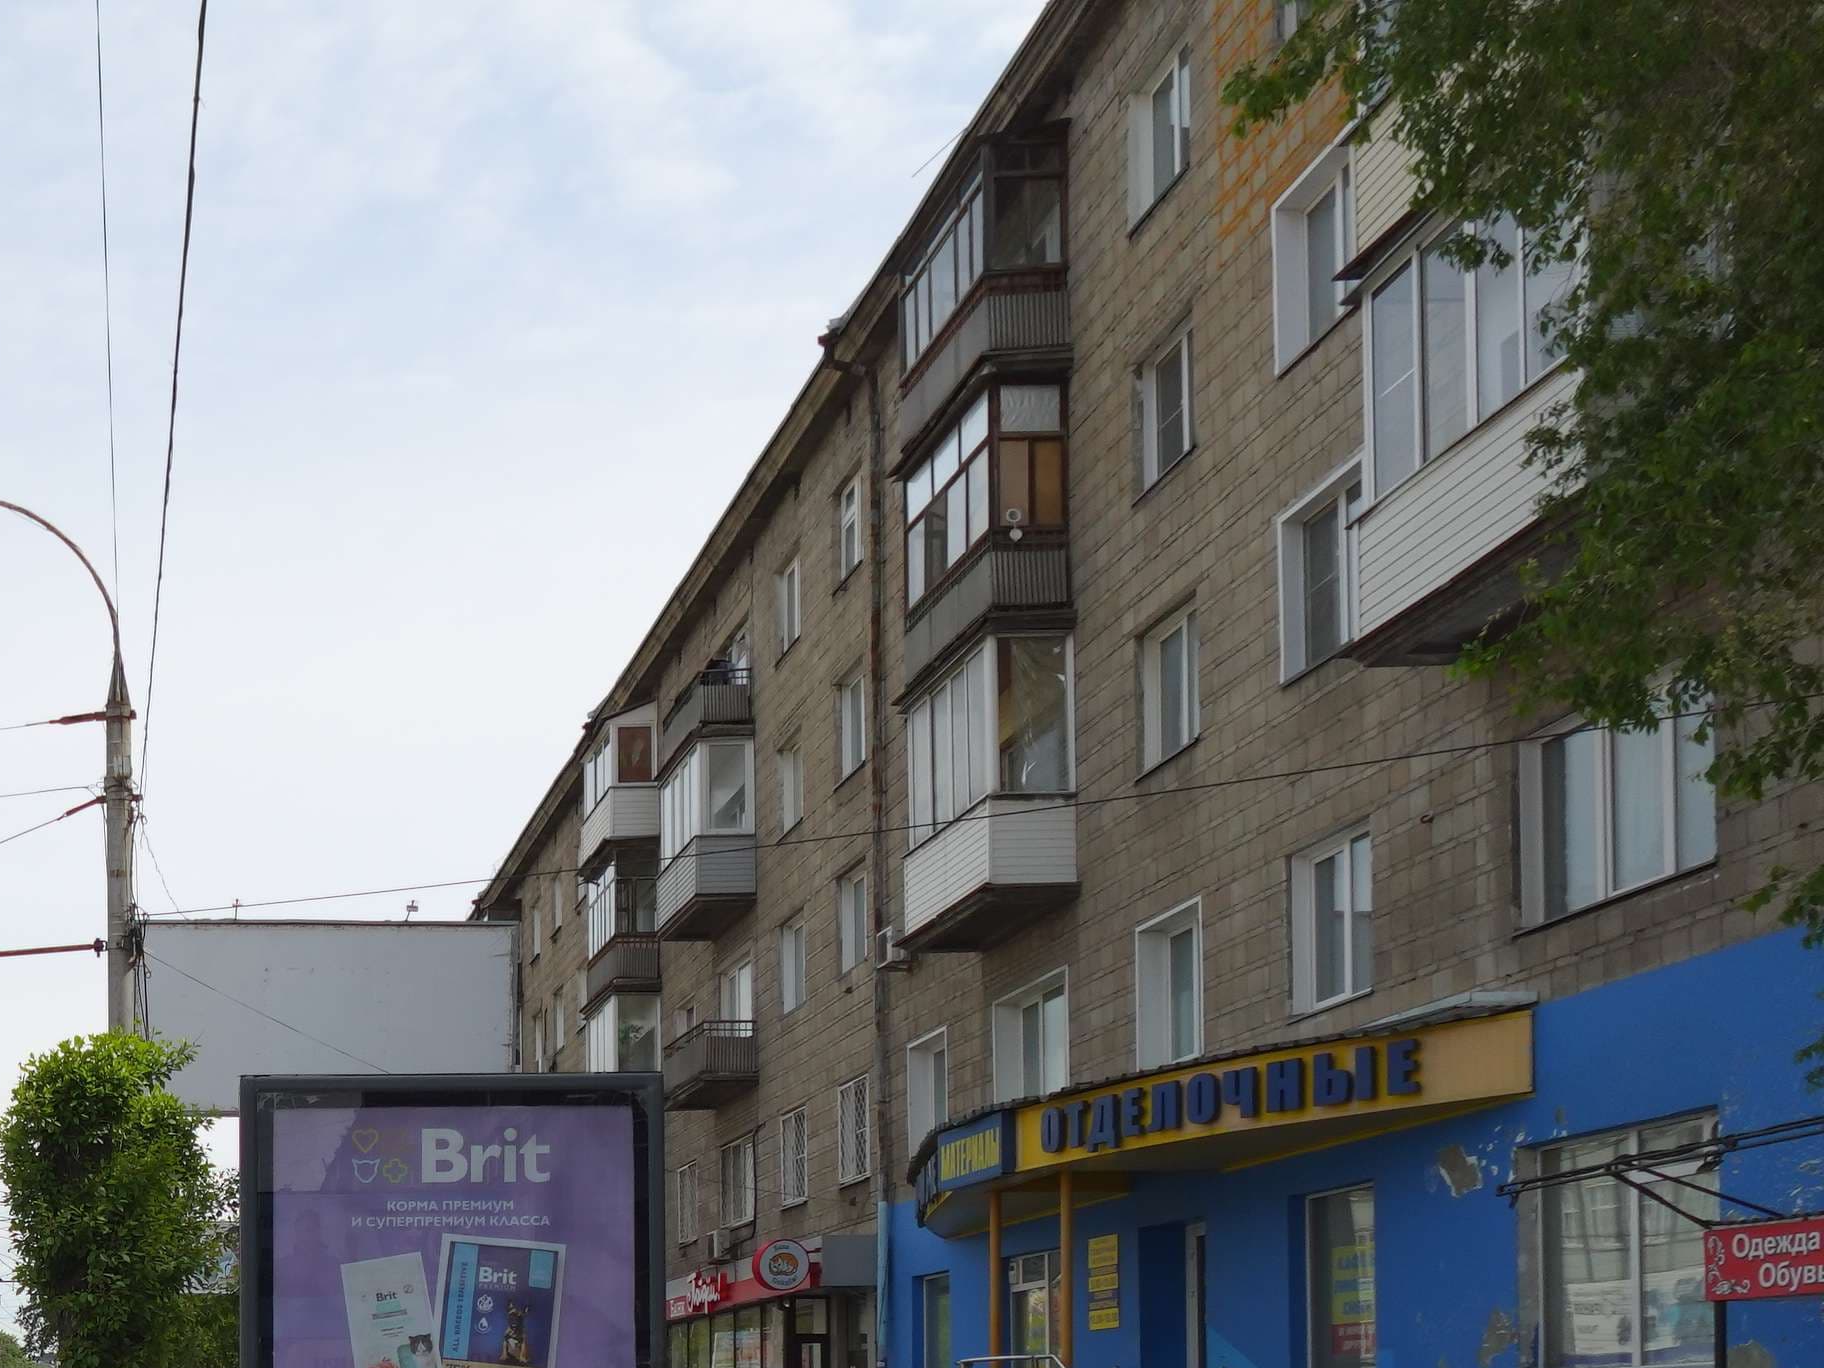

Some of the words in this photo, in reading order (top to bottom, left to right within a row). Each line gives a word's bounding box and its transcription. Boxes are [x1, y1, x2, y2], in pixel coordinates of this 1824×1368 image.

[1040, 1038, 1421, 1154] ОТДЕЛОЧНЫЕ
[421, 1127, 551, 1183] Brit
[940, 1127, 1000, 1182] МАТЕРИАЛЫ
[386, 1200, 439, 1211] КОРМА
[442, 1199, 514, 1212] ПРЕМИУМ
[351, 1216, 362, 1227] И
[366, 1215, 486, 1229] СУПЕРПРЕМИУМ
[489, 1215, 551, 1226] КЛАССА
[1732, 1231, 1821, 1261] Одежда
[479, 1266, 518, 1285] Brit
[376, 1291, 398, 1302] Brit
